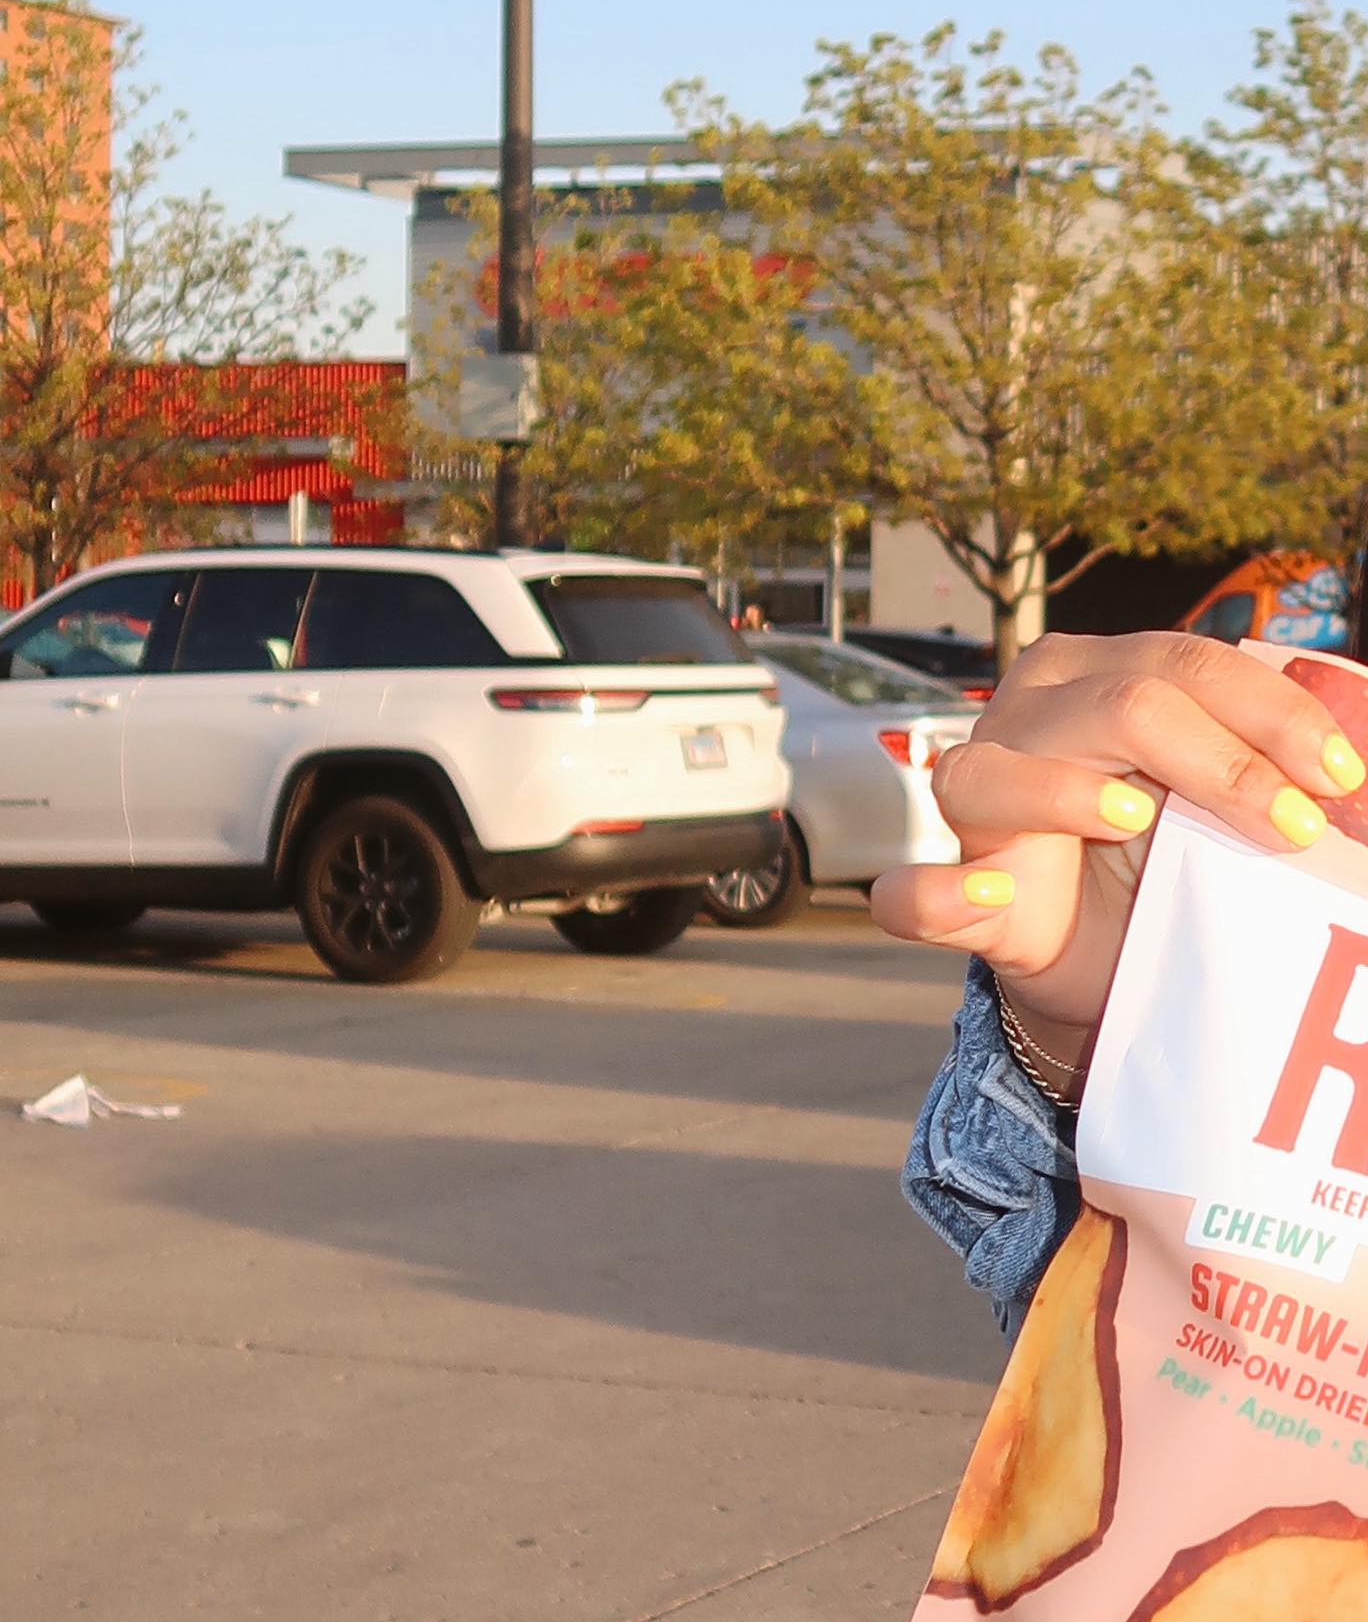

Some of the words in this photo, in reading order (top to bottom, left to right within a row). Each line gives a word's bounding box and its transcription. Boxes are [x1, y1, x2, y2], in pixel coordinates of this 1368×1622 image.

[1202, 1203, 1337, 1265] CHEWY
[1175, 1323, 1291, 1392] SKIN-ON
[1156, 1357, 1213, 1402] Pear
[1235, 1395, 1323, 1448] Apple
